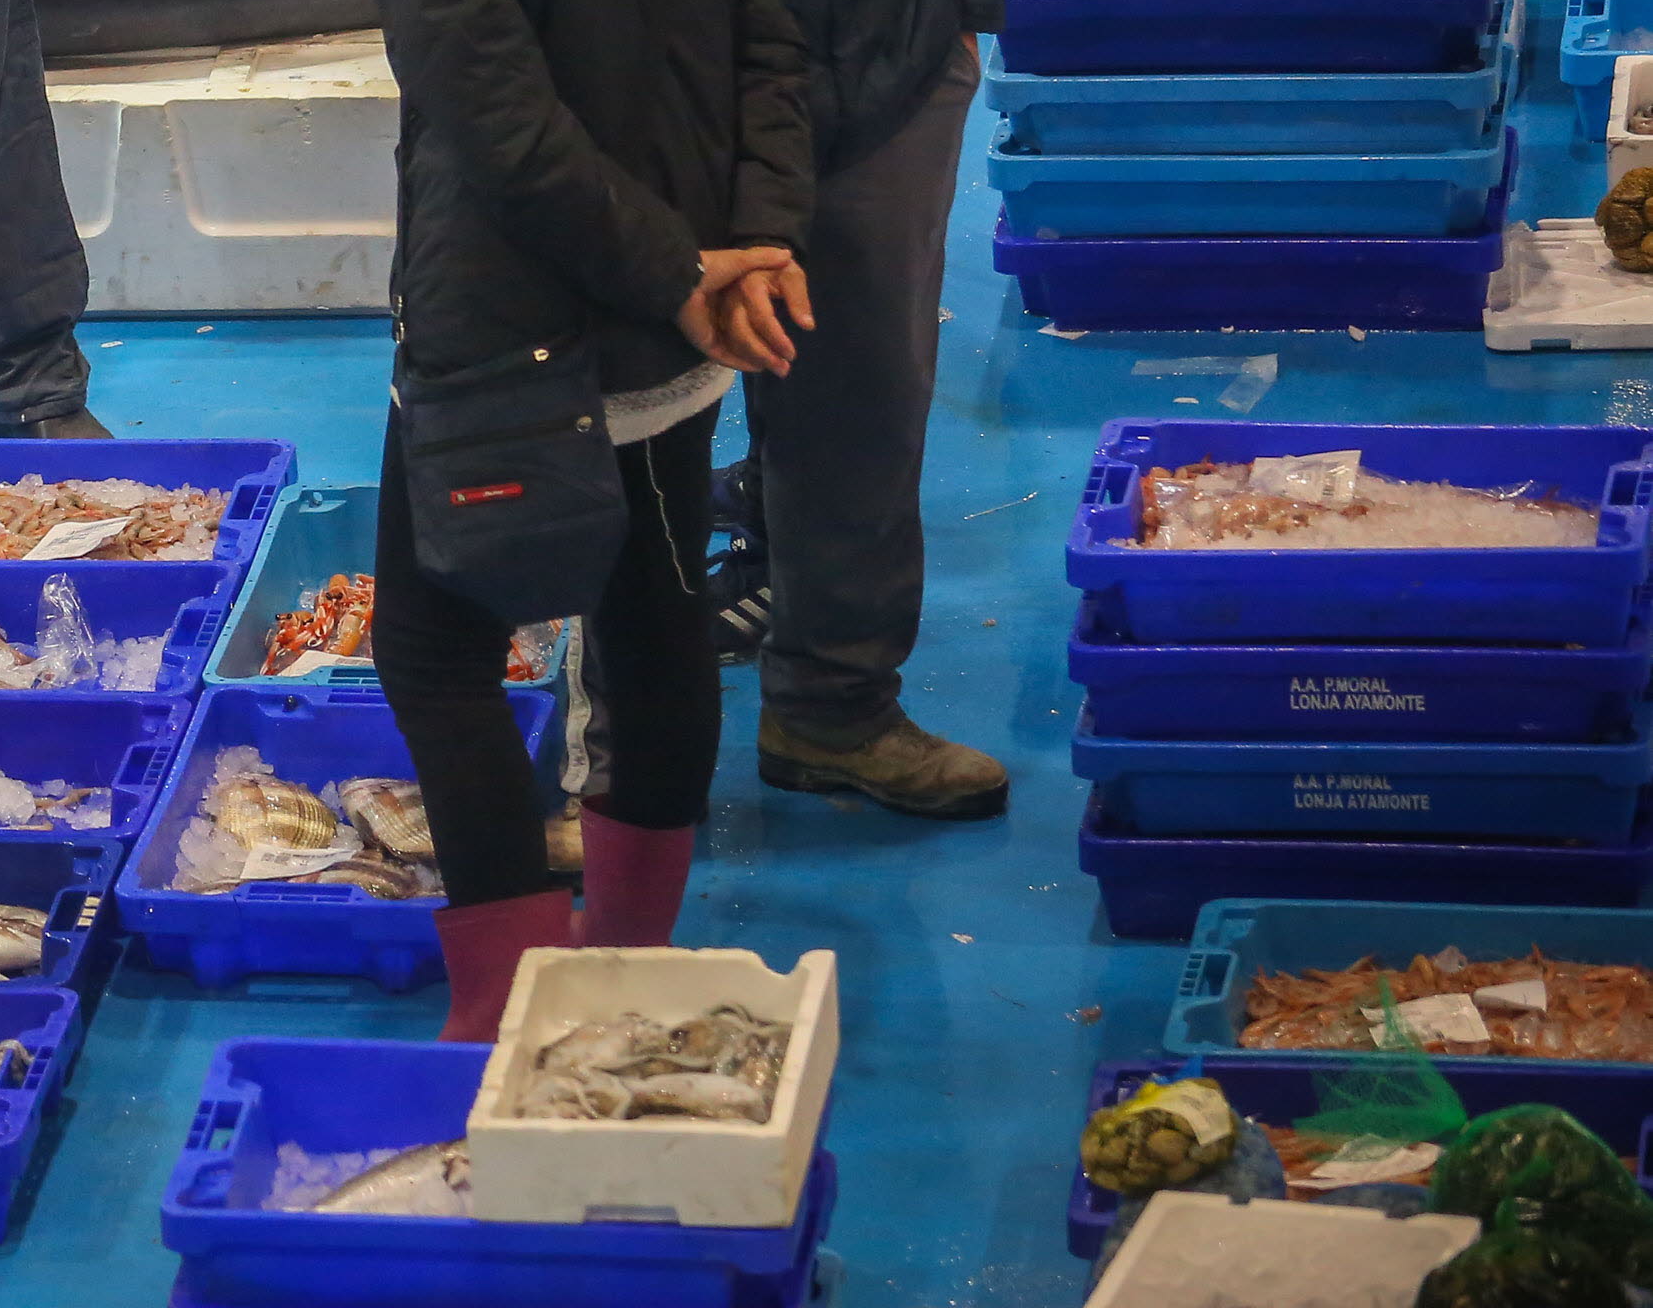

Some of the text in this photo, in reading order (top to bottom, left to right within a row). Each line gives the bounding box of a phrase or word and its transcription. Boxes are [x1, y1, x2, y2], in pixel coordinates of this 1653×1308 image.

[1291, 676, 1320, 692] A.A.
[1290, 694, 1426, 711] LONJA AYAMONTE
[1295, 793, 1431, 810] LONJA AYAMONTE
